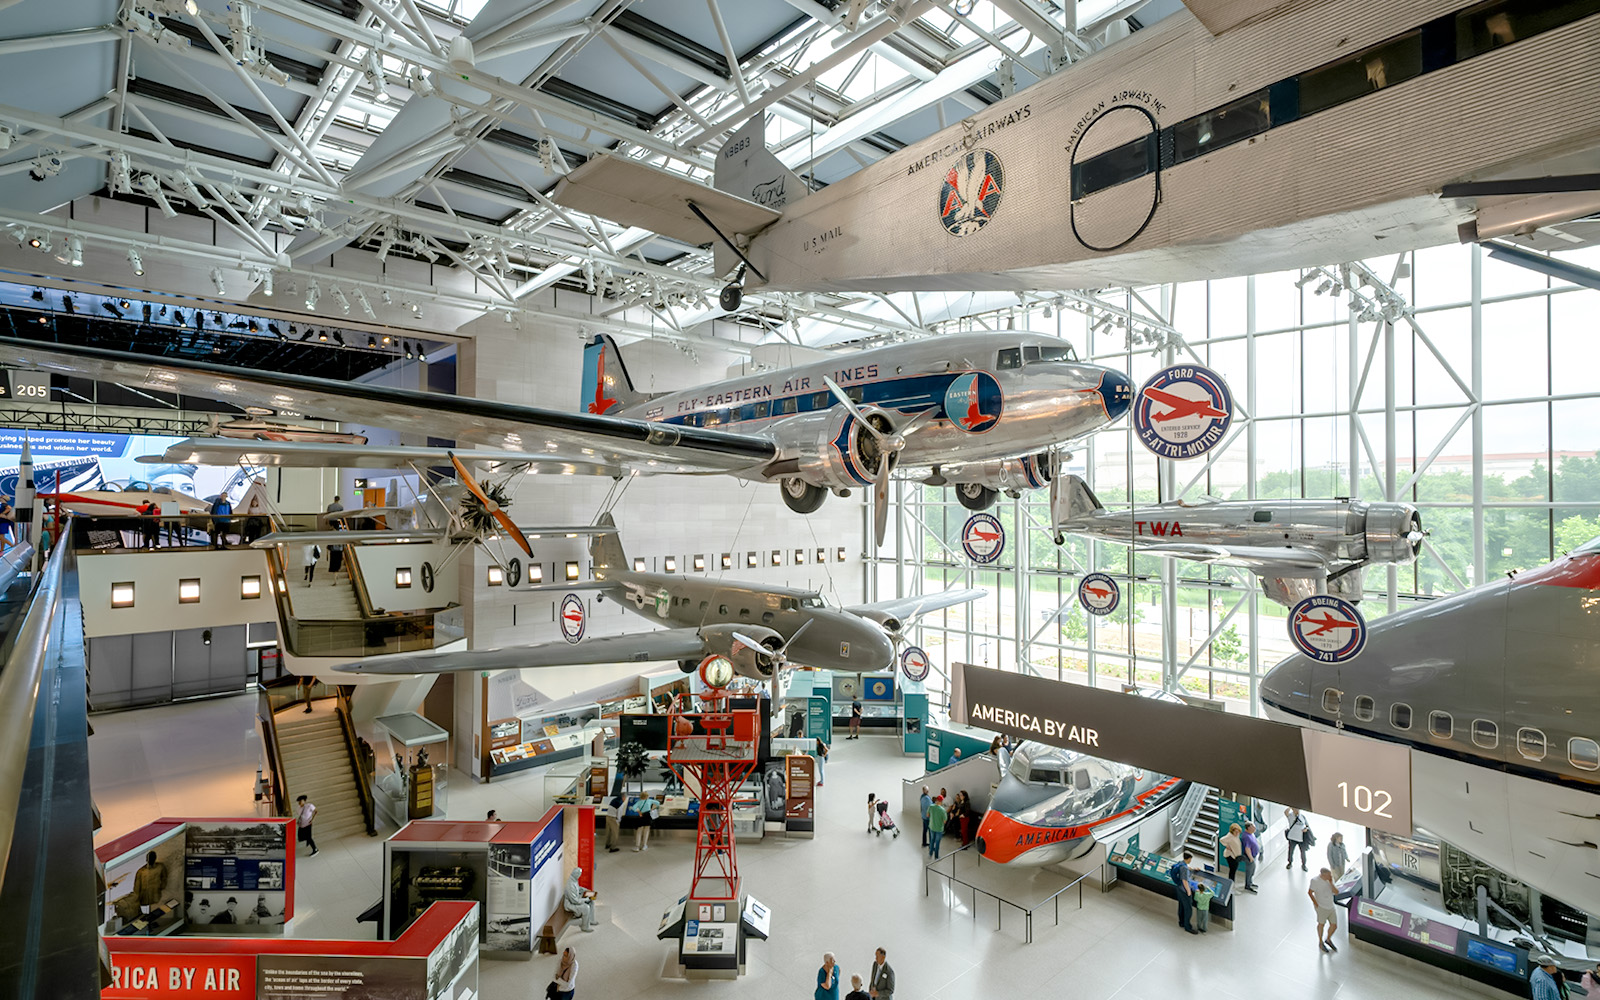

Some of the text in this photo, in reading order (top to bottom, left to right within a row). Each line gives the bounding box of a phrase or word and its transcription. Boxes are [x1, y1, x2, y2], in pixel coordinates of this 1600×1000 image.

[975, 104, 1031, 140] AIRWAYS
[1064, 90, 1167, 152] AMERICAN AIRWAYS INC
[752, 174, 786, 205] Ford
[820, 226, 843, 243] MAIL
[782, 377, 810, 393] AIR
[823, 364, 878, 386] INES
[1168, 368, 1194, 380] FORD
[17, 384, 47, 397] 205
[949, 390, 977, 399] EASTERN
[0, 435, 17, 443] lying
[1142, 425, 1223, 457] 5-AT TRI-MOTOR
[1135, 521, 1183, 537] TWA
[1311, 598, 1339, 608] BOEING
[1318, 651, 1334, 661] 747
[971, 703, 1099, 748] AMERICA BY AIR
[1337, 781, 1393, 819] 102
[1015, 827, 1078, 846] AMERICAN
[110, 966, 240, 991] RICA BY AIR
